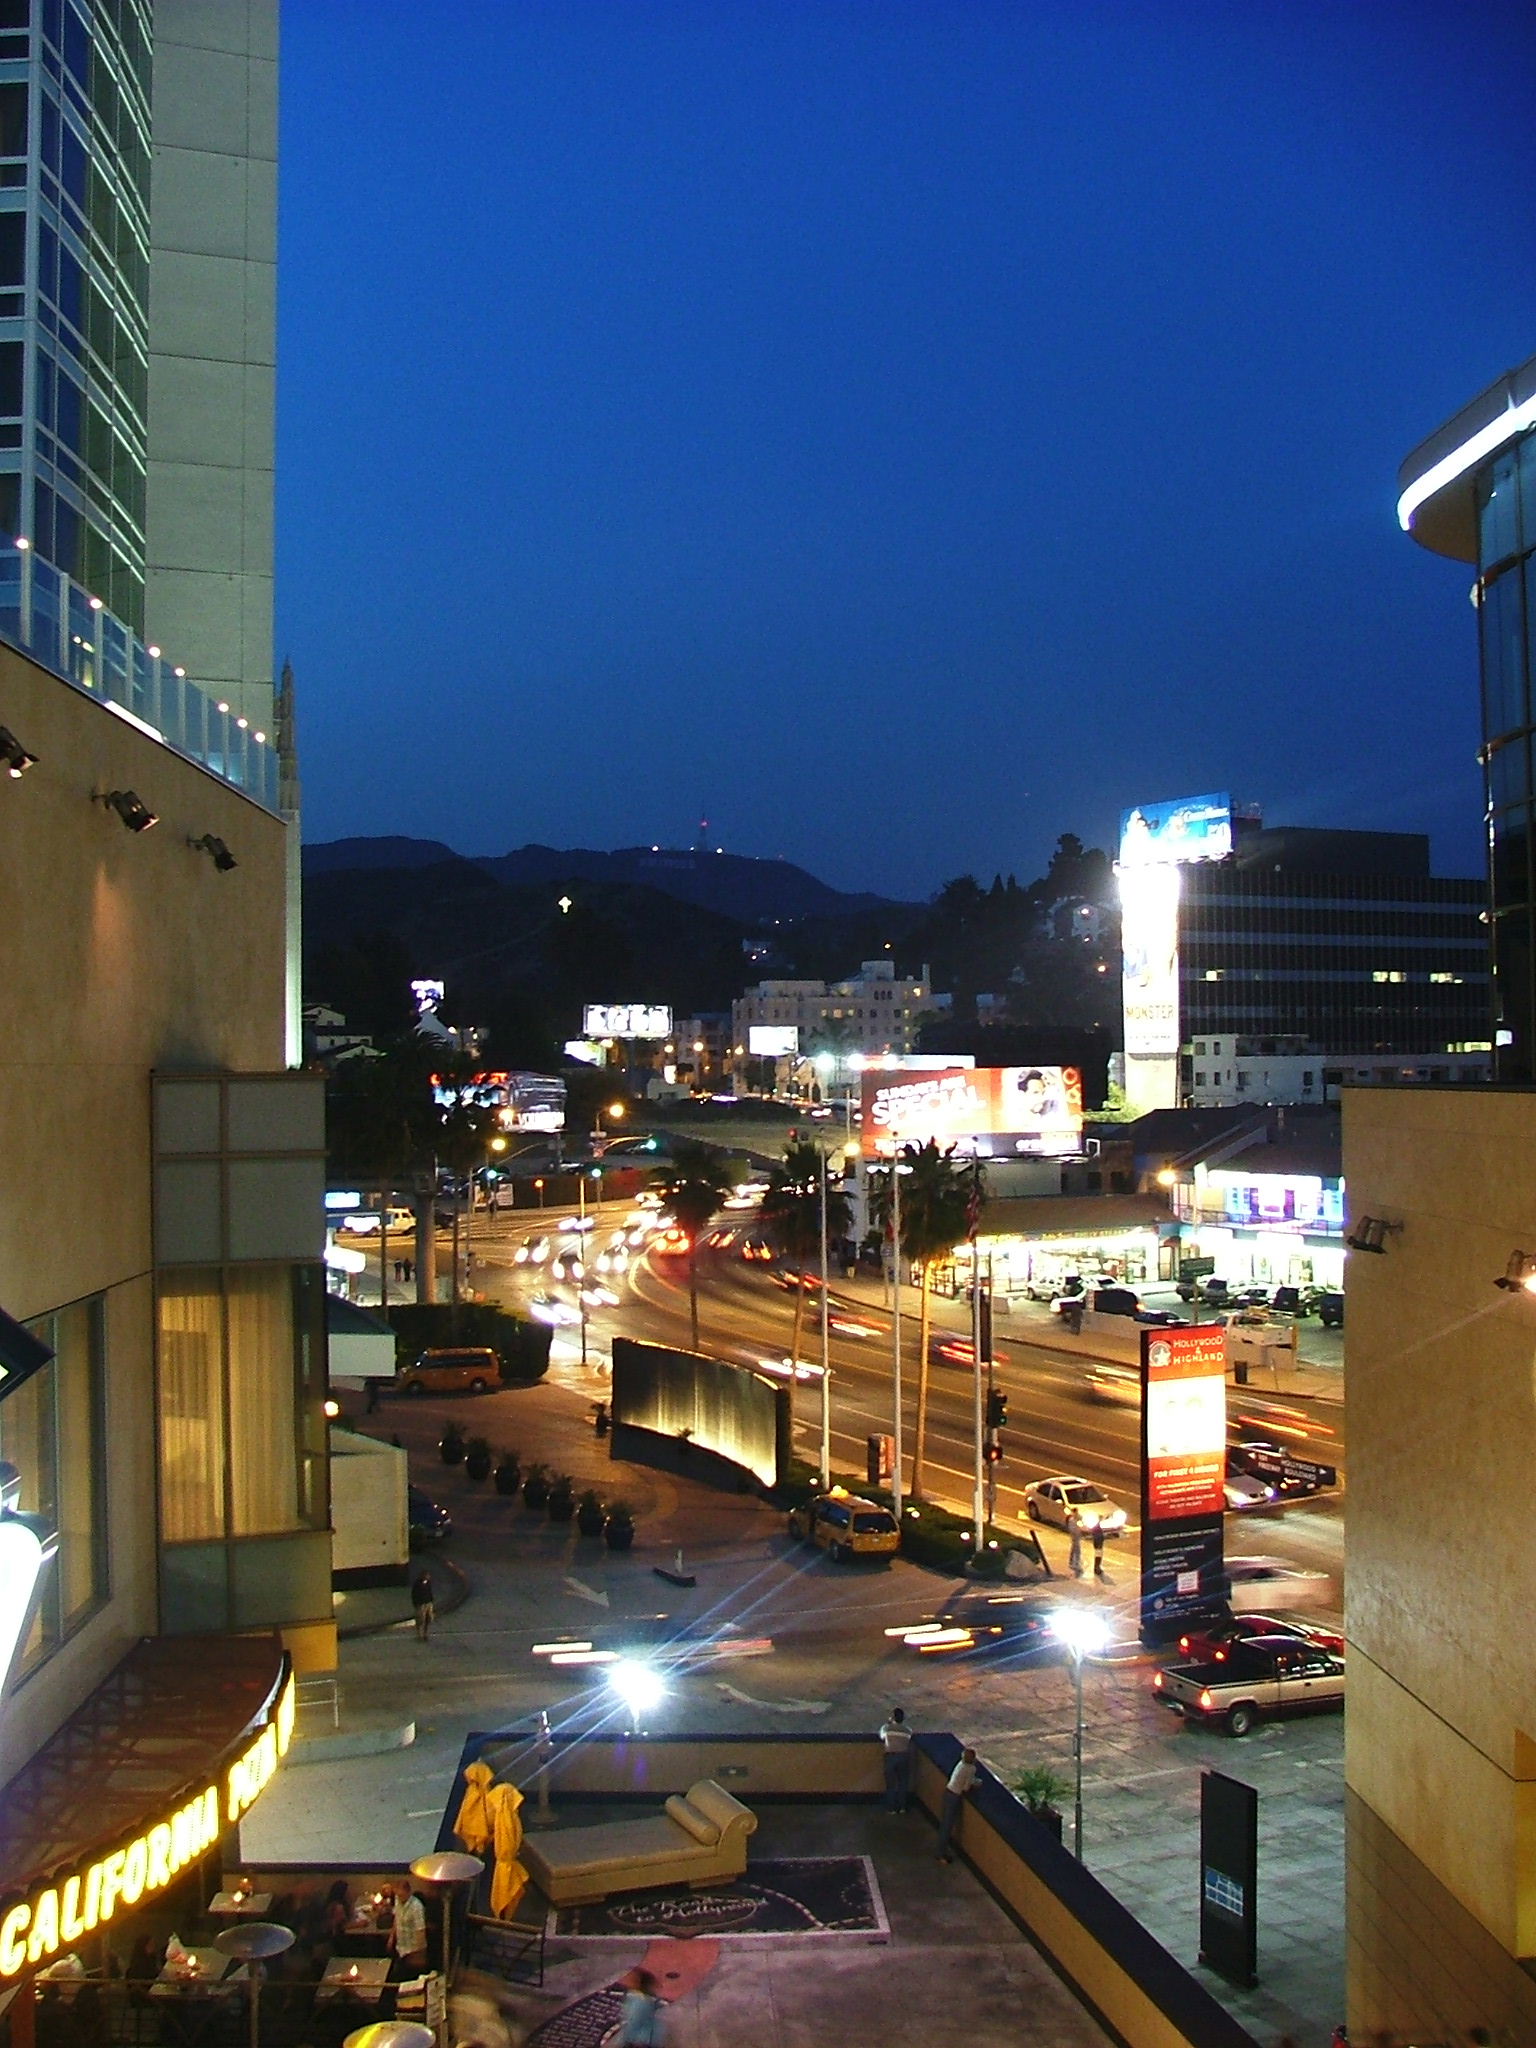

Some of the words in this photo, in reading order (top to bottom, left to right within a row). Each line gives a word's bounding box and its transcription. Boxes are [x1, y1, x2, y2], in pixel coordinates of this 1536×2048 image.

[1173, 1335, 1224, 1348] HOLLYWOOD
[1173, 1352, 1225, 1365] HIGHLAND
[0, 1784, 219, 1976] CALIFORNIA
